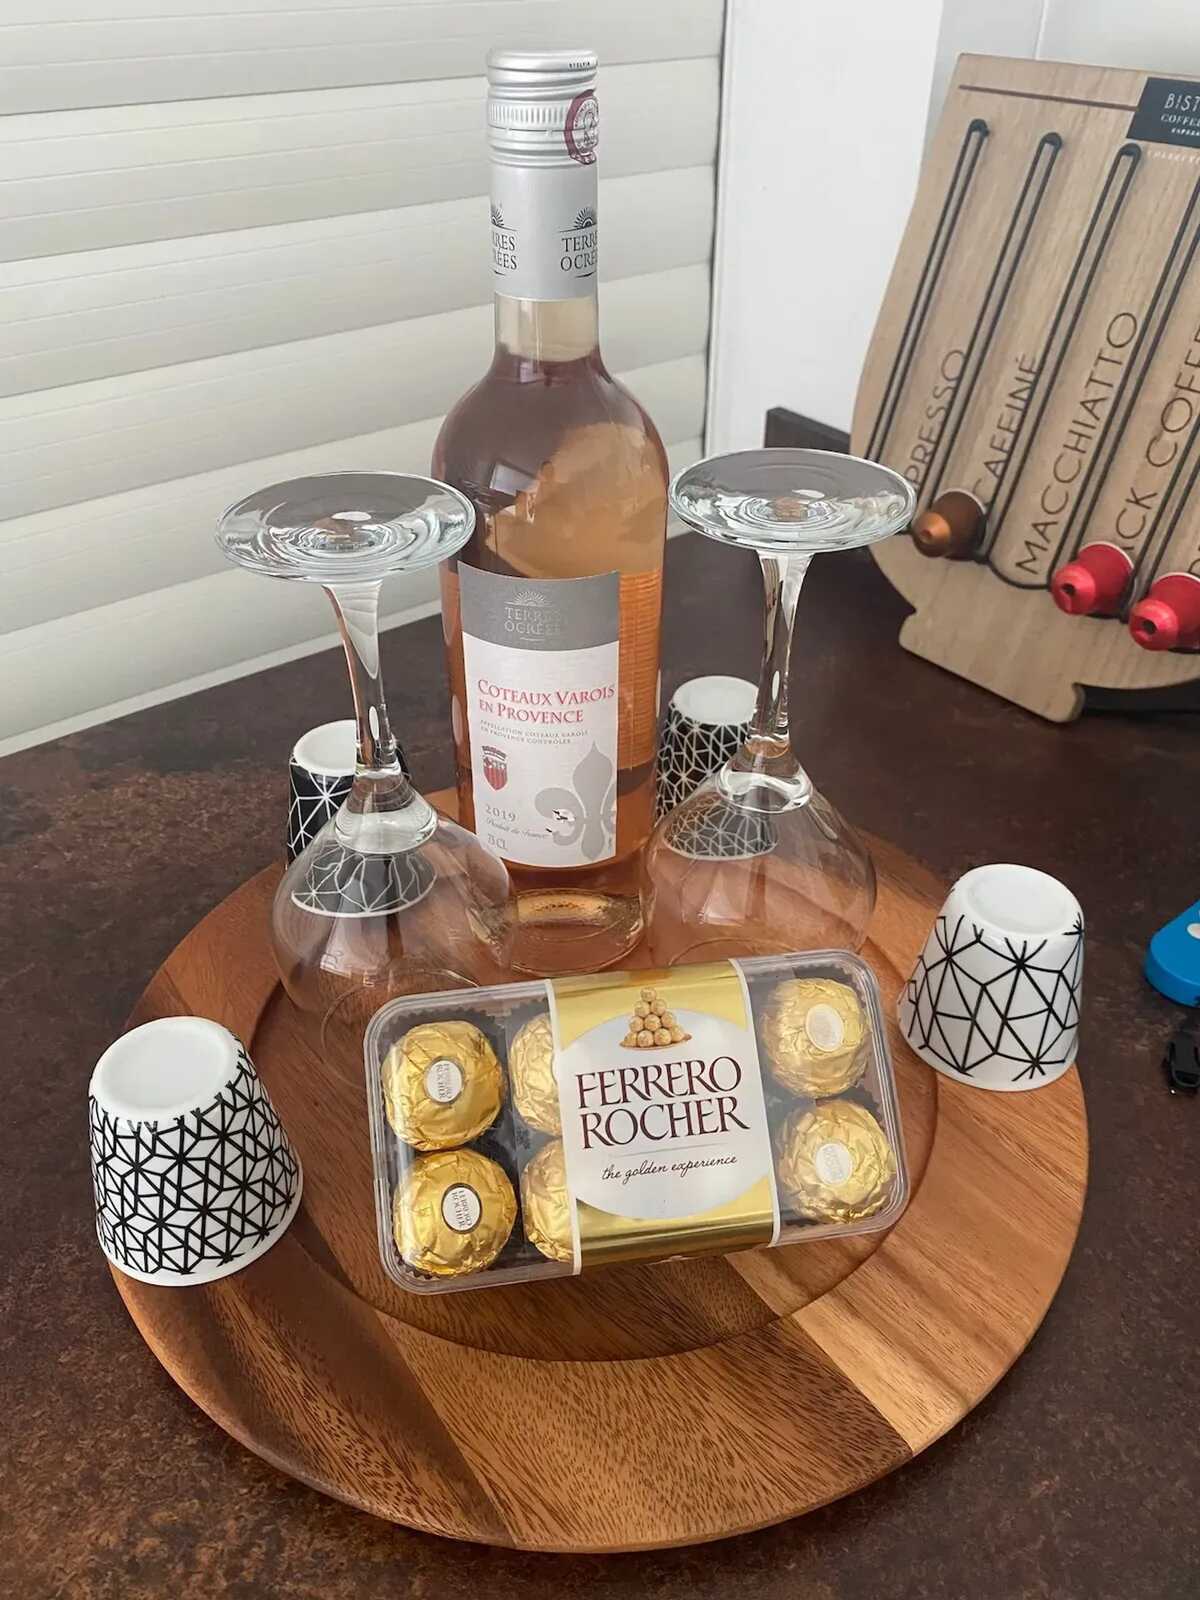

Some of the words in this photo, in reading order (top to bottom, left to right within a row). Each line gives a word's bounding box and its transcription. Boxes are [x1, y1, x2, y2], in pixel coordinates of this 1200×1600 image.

[492, 231, 515, 251] RES
[561, 231, 598, 252] TERR
[1015, 312, 1138, 574] MACCHIATTO
[478, 679, 552, 706] COTEAUX
[555, 684, 615, 706] VAROIS
[479, 700, 494, 713] EN
[497, 702, 584, 724] PROVENCE
[485, 802, 517, 822] 2019
[575, 1055, 742, 1110] FERRERO
[579, 1095, 751, 1149] ROCHER
[601, 1163, 622, 1180] the
[622, 1159, 668, 1184] golden
[671, 1156, 738, 1178] experience
